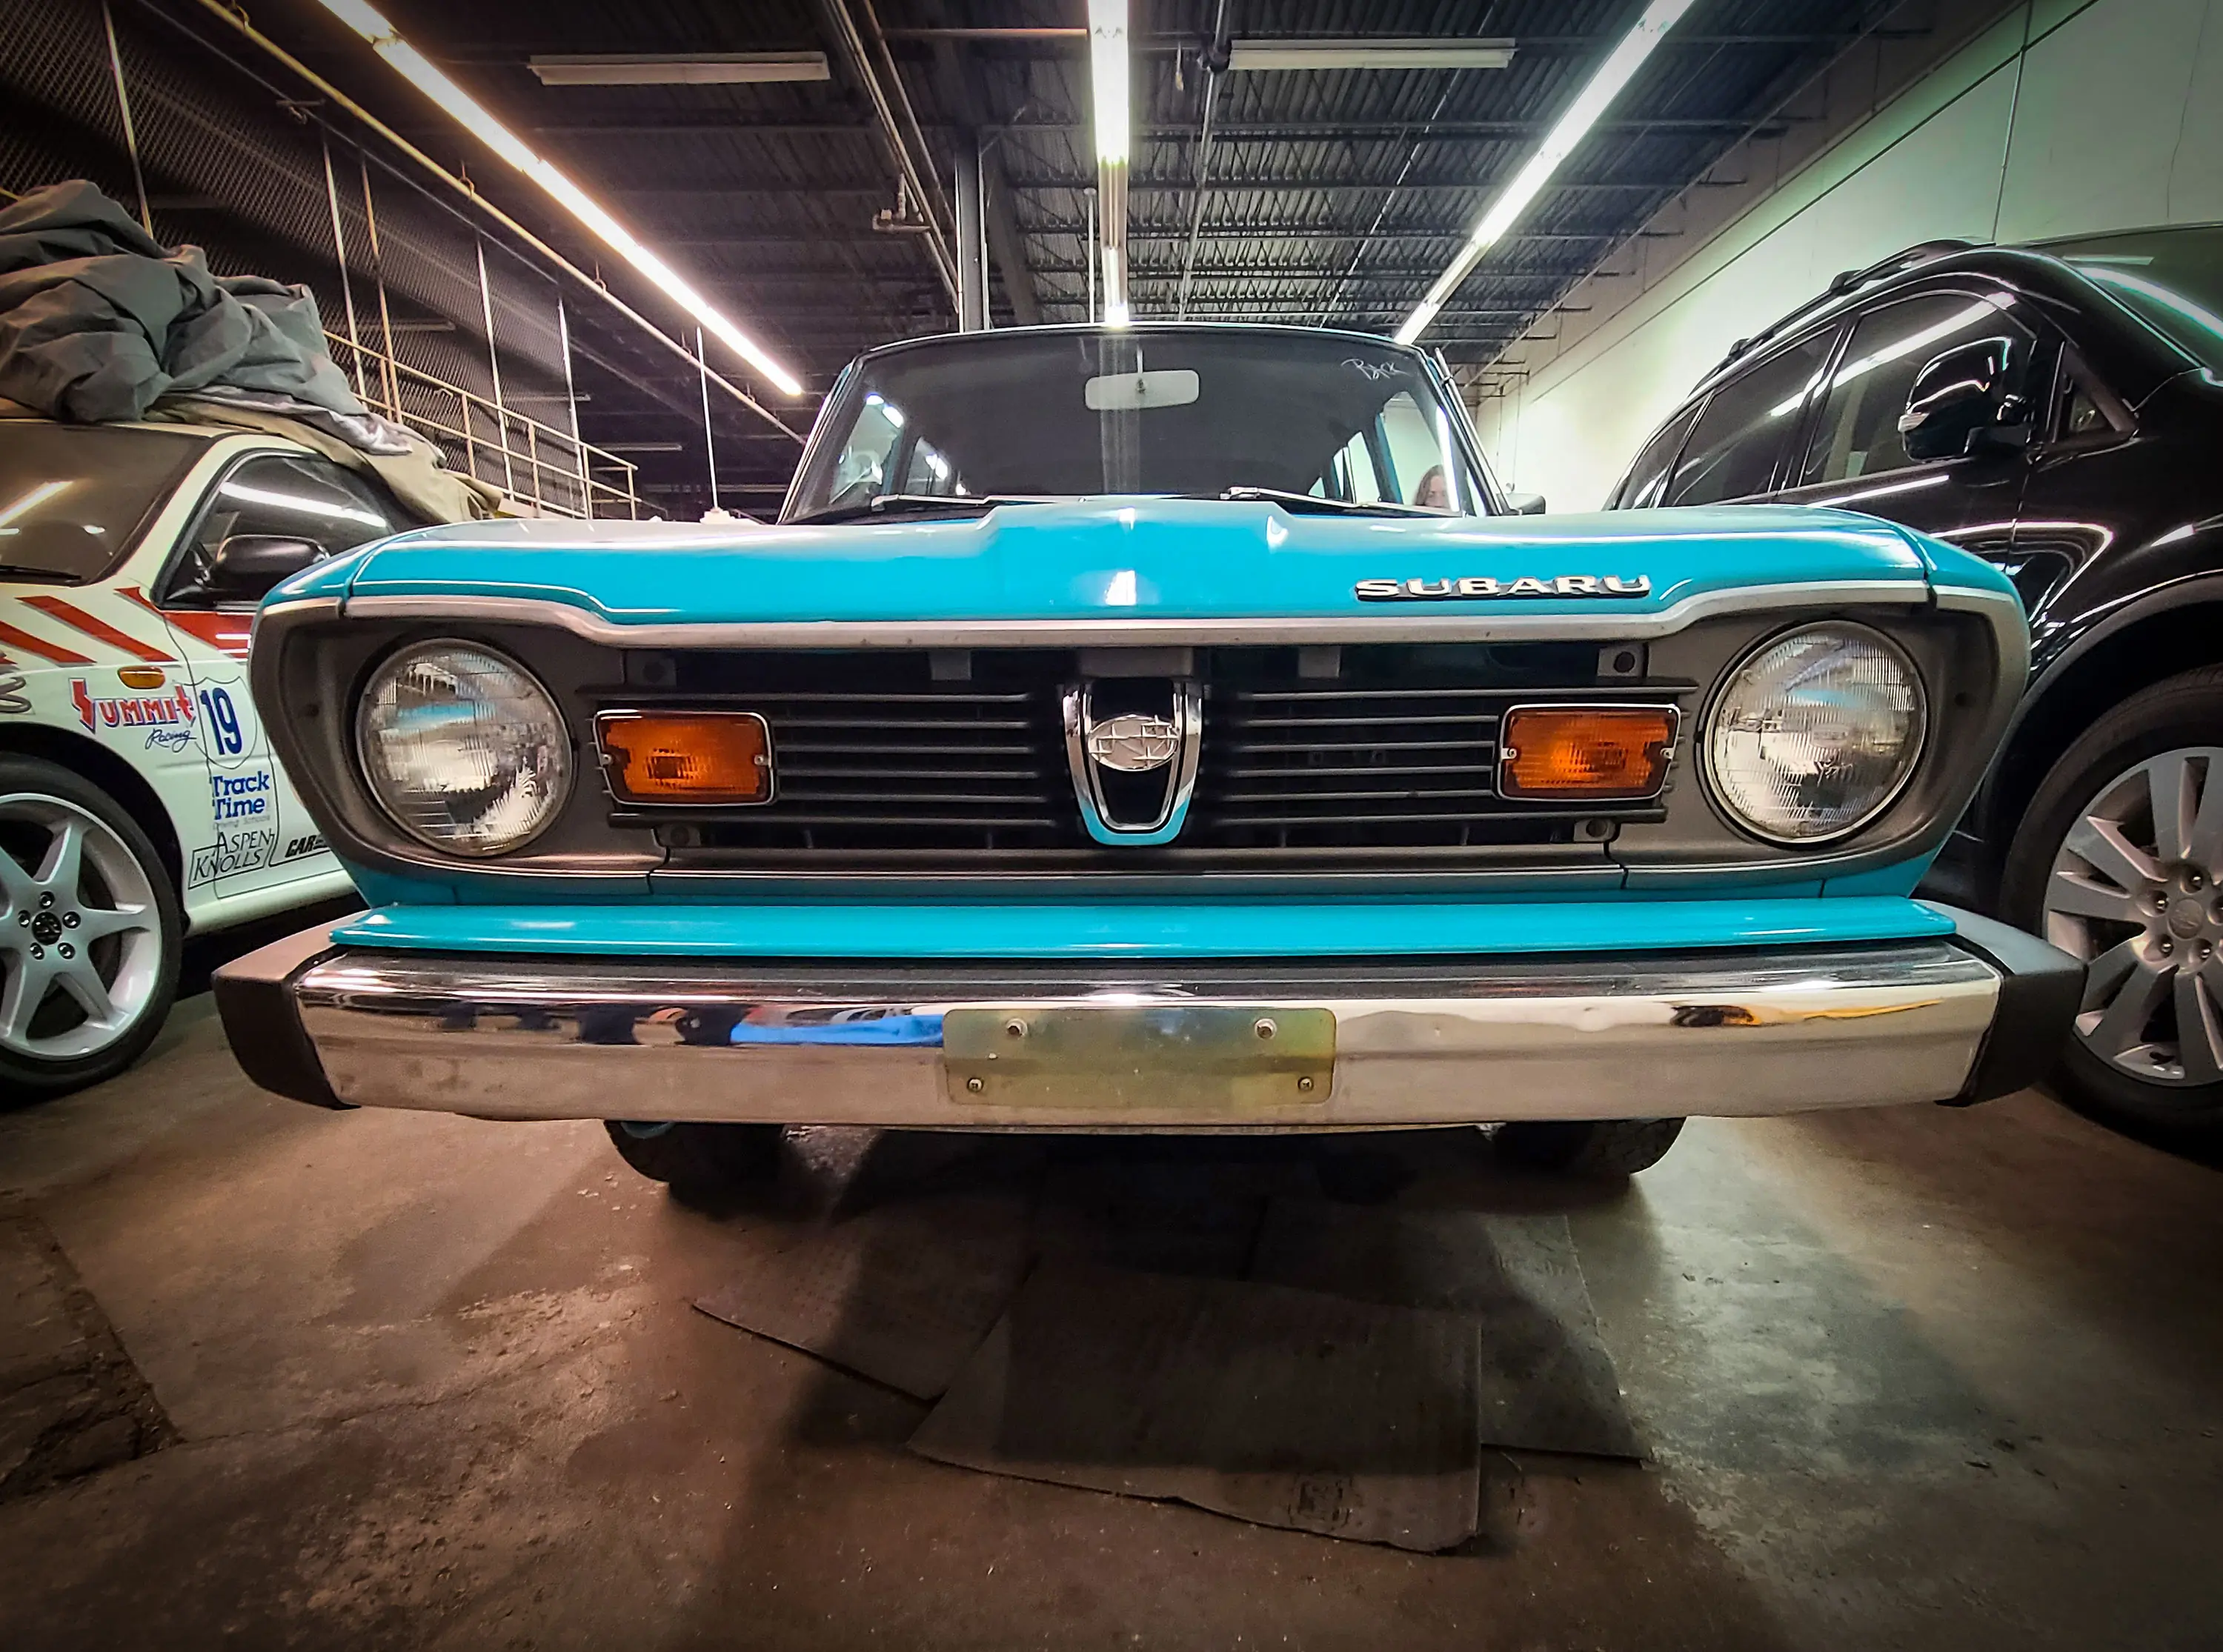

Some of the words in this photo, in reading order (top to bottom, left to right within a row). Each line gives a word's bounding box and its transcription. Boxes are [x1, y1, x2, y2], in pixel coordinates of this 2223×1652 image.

[1355, 574, 1650, 602] SUBARU
[199, 687, 243, 756] 19
[144, 728, 197, 753] Racing
[210, 770, 270, 797] Track
[212, 796, 265, 821] Time
[217, 827, 273, 853] ASPEN
[193, 848, 264, 882] KNOLLS
